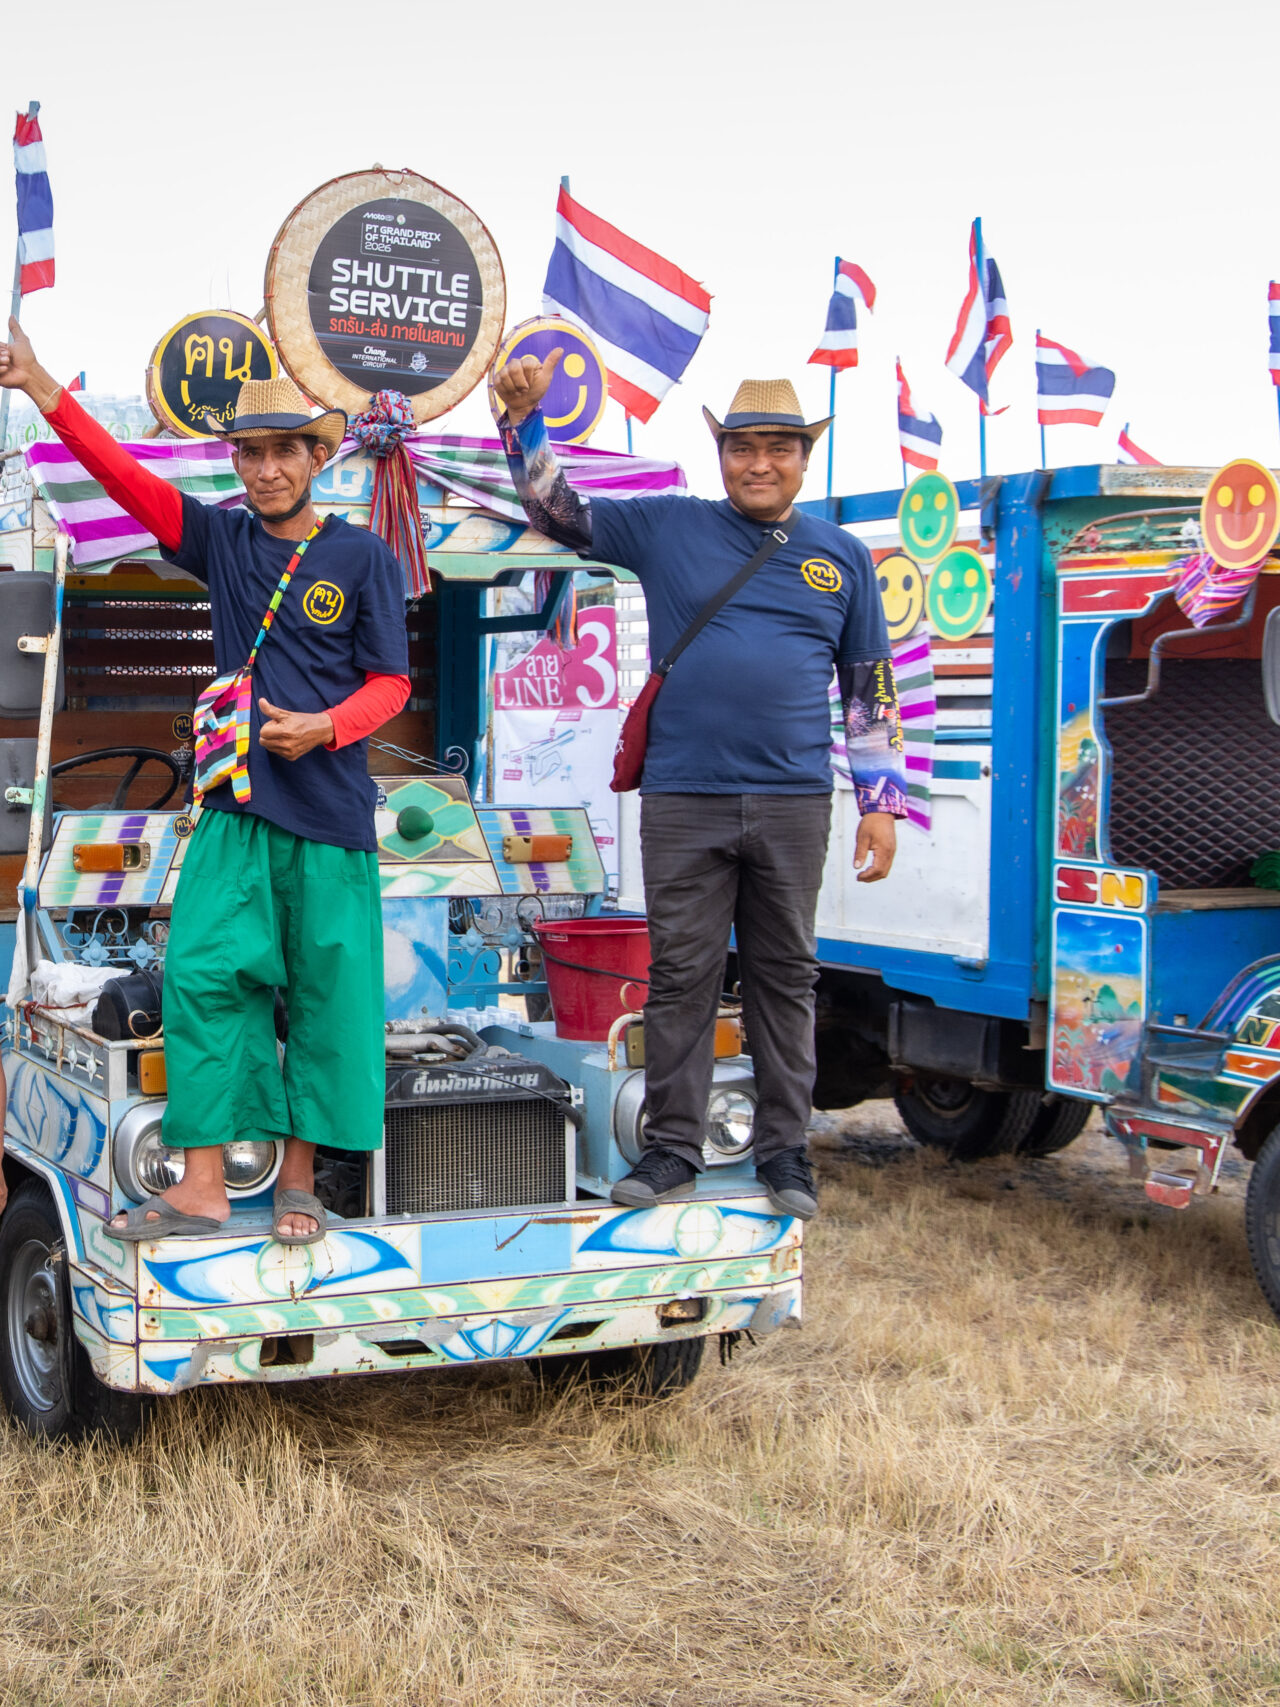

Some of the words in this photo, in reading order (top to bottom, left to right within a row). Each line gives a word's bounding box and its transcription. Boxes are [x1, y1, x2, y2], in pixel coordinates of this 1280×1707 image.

[365, 233, 379, 242] OF
[381, 235, 432, 249] THAILAND
[366, 224, 379, 233] PT
[380, 226, 414, 239] GRAND
[415, 230, 441, 242] PRIX
[365, 242, 392, 253] 2026
[332, 258, 470, 299] SHUTTLE
[329, 288, 468, 328] SERVICE
[329, 316, 388, 338] รถรับ-ส่ง
[391, 323, 465, 347] ภายในสนาม
[352, 354, 397, 365] INTERNATIONAL
[363, 346, 387, 357] Chang
[362, 361, 387, 369] CIRCUIT
[526, 653, 559, 677] สาย
[576, 621, 617, 708] 3
[498, 675, 564, 708] LINE
